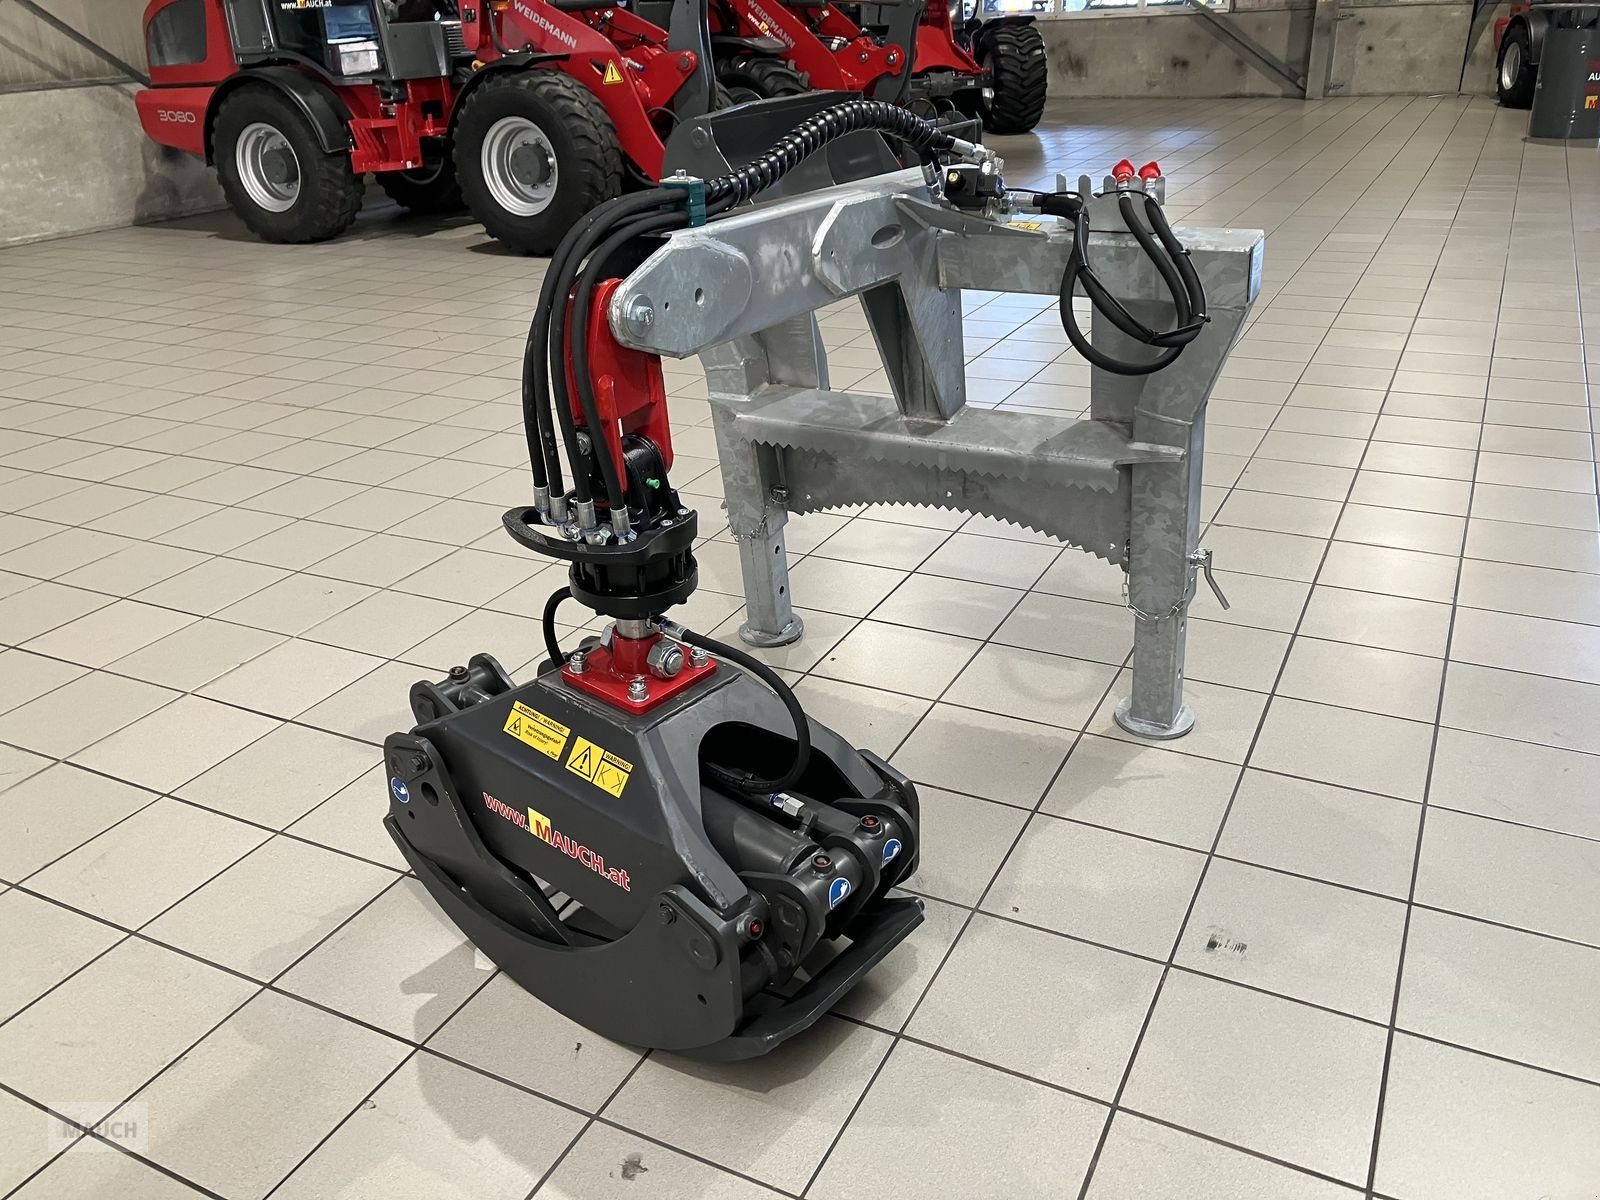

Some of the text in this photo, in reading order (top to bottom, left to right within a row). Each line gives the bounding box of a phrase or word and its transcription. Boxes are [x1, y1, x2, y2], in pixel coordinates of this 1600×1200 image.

[514, 0, 577, 48] WEIDEMANN
[748, 0, 796, 48] WEIDEMANN
[157, 110, 196, 123] 3080
[605, 752, 632, 771] WARNING!
[482, 791, 631, 892] www.MAUCH.at
